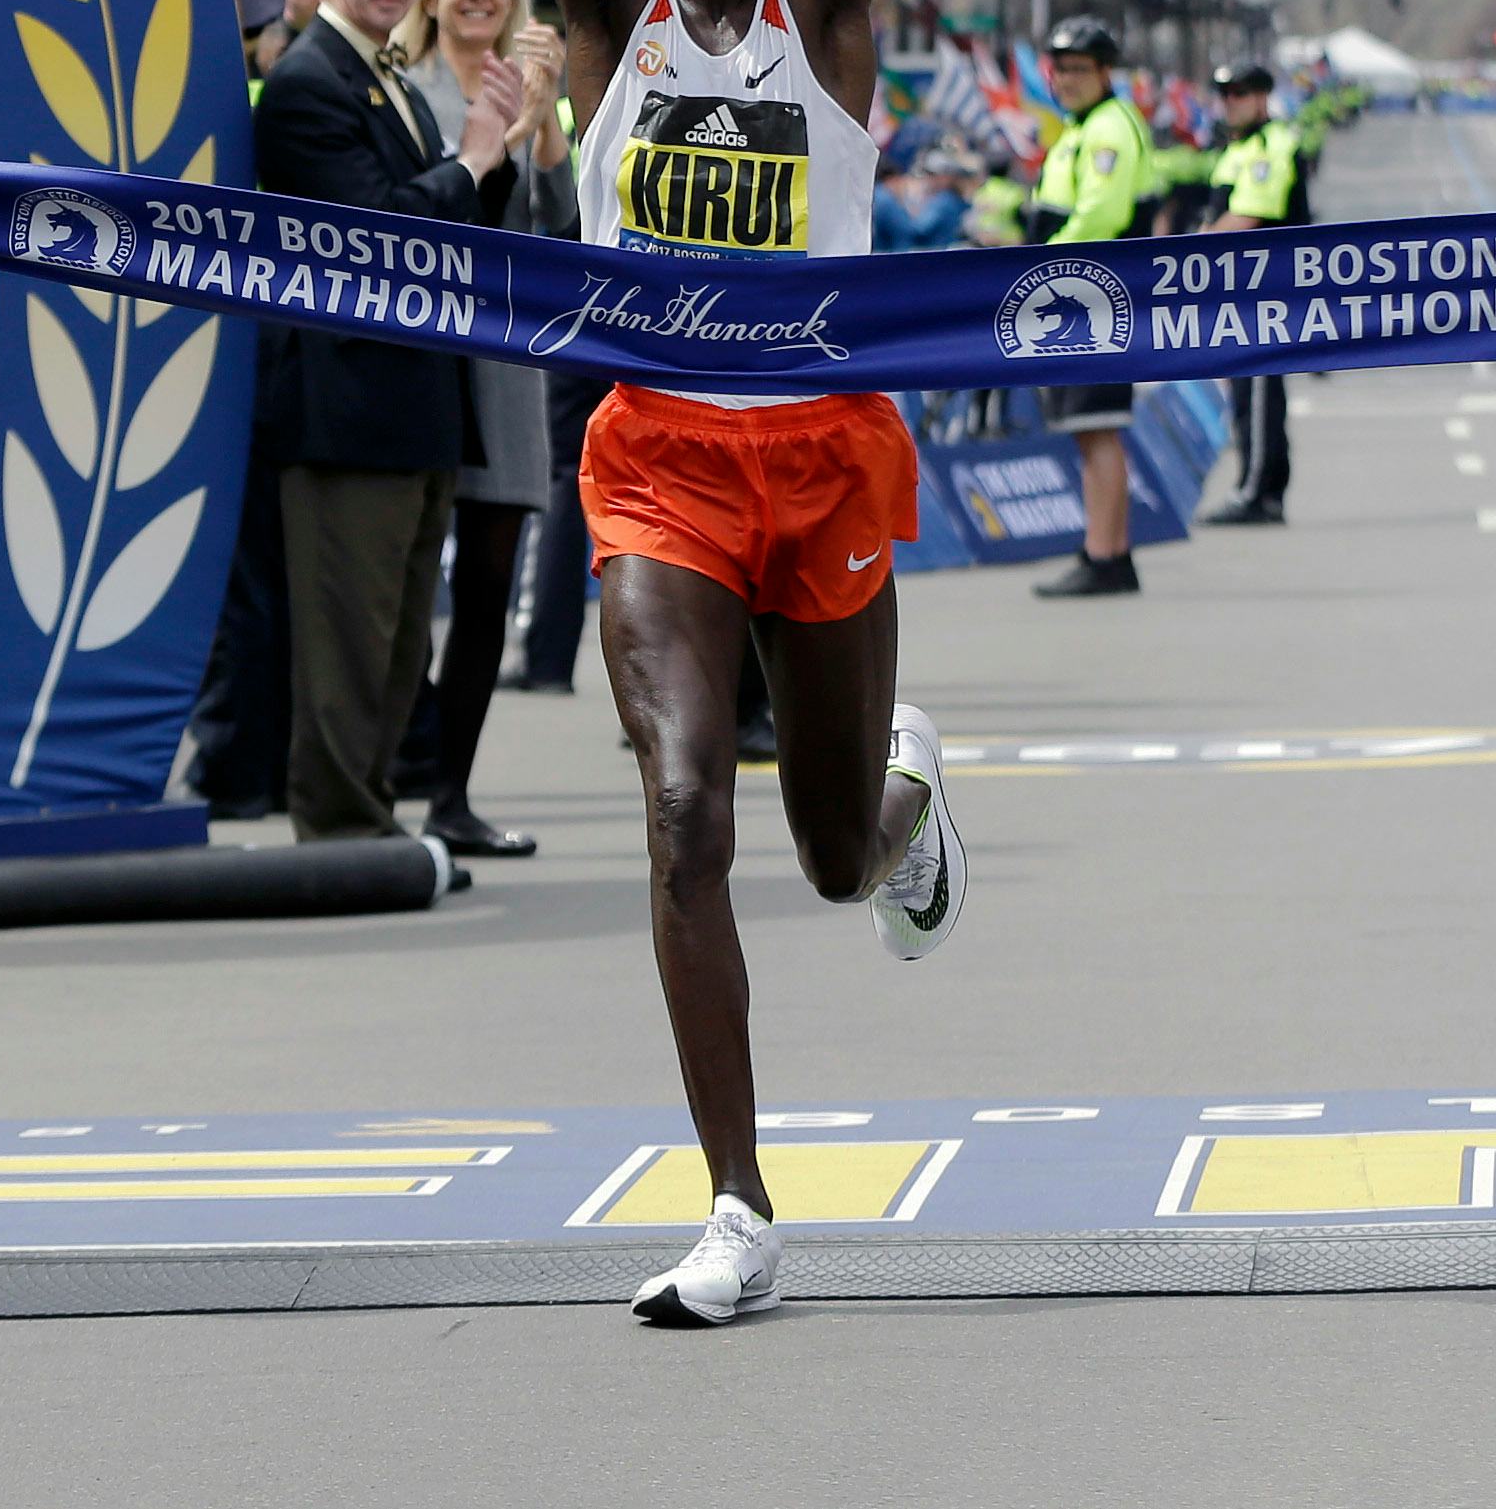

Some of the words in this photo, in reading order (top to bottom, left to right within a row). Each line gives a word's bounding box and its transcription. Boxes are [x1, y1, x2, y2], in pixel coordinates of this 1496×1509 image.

[685, 128, 749, 148] adidas
[14, 201, 32, 252] BOSTON
[82, 197, 133, 268] ASSOCIATION
[630, 148, 795, 247] KIRUI
[146, 200, 256, 244] 2017
[278, 215, 474, 286] BOSTON
[1152, 249, 1270, 295] 2017
[146, 238, 477, 338] MARATHON
[528, 270, 656, 357] John
[649, 283, 851, 361] Hancock
[1000, 299, 1020, 349] BOSTON
[1015, 262, 1081, 299] ATHLETIC
[1082, 265, 1129, 343] ASSOCIATION
